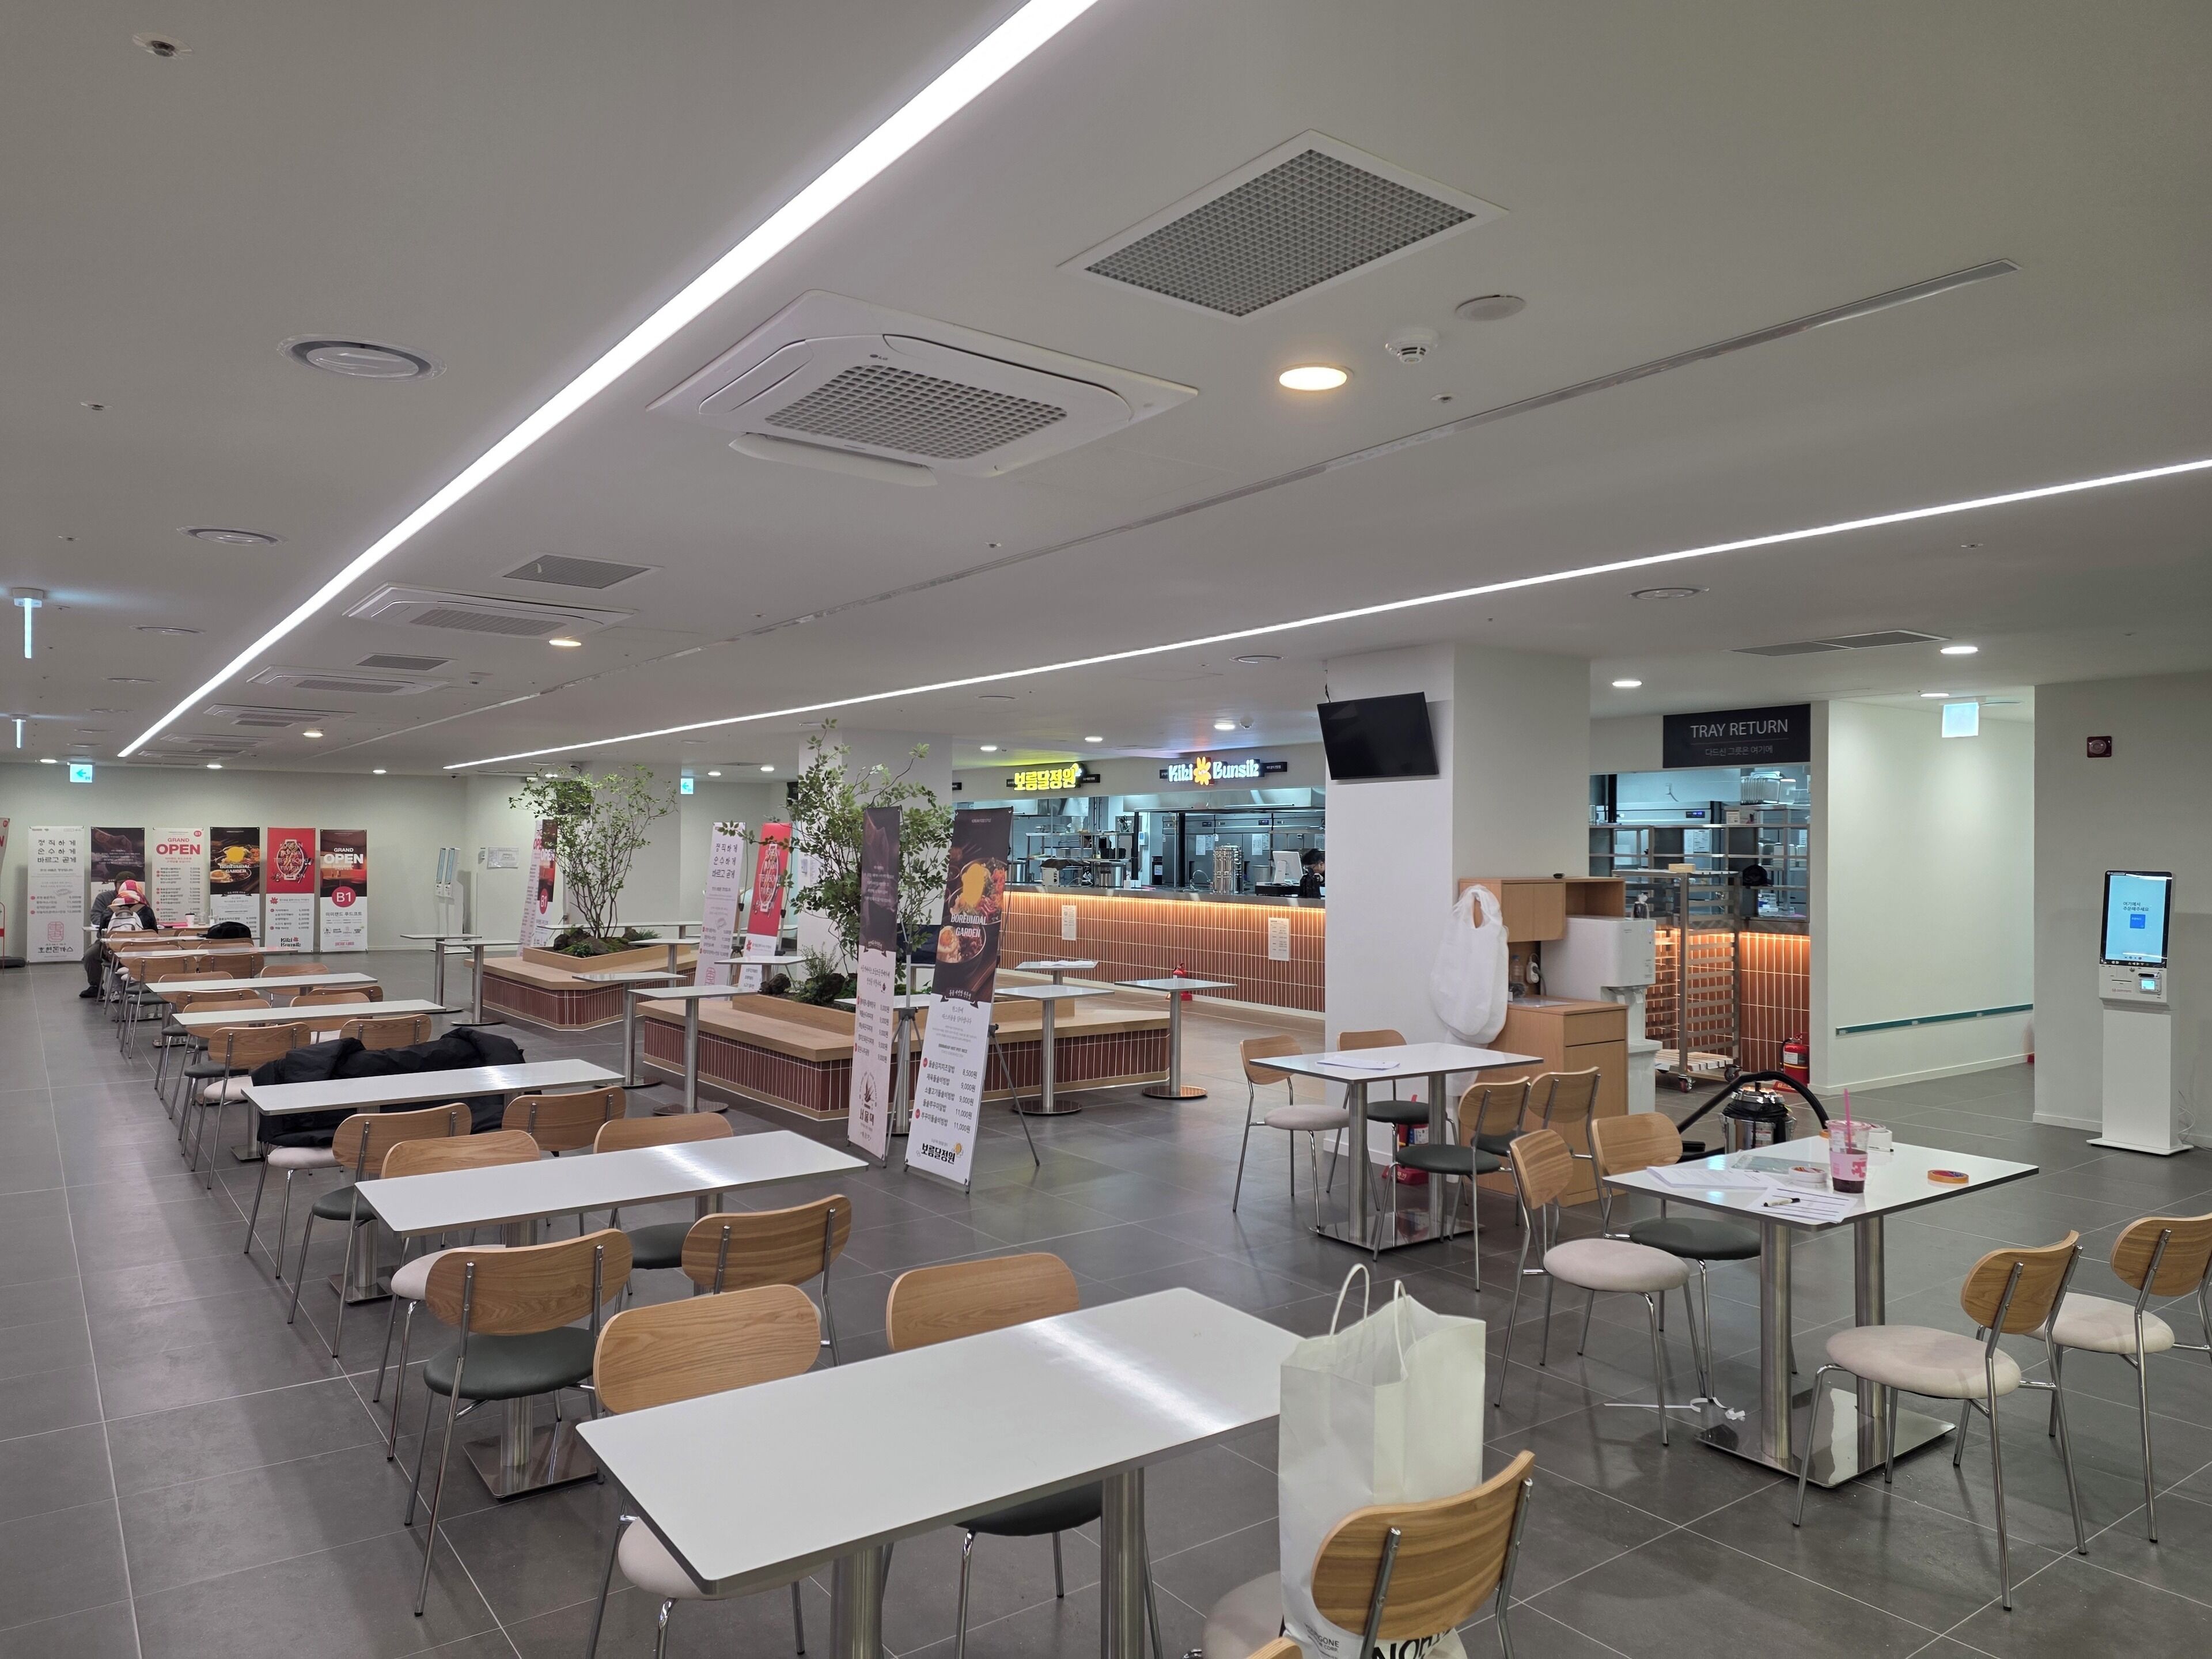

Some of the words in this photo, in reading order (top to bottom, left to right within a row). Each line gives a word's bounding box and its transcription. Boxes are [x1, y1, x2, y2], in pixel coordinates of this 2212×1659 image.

[1690, 724, 1726, 738] TRAY
[1730, 719, 1788, 736] RETURN
[1705, 748, 1726, 756] 다드신
[1728, 747, 1749, 756] 그릇은
[1751, 745, 1773, 754] 여기에
[1169, 764, 1193, 782] Kiki
[1213, 759, 1259, 779] Bunsik
[1014, 768, 1076, 790] 보름달정원
[156, 844, 200, 855] OPEN
[324, 853, 364, 864] OPEN
[336, 892, 351, 902] B1
[540, 896, 547, 907] B1
[951, 914, 987, 925] BOREUMDAL
[956, 927, 980, 938] GARDEN
[963, 1069, 978, 1079] 8,500원
[960, 1082, 976, 1093] 9,000원
[959, 1095, 974, 1106] 9,000원
[956, 1108, 972, 1120] 11,000원
[954, 1122, 971, 1134] 11,000원
[922, 1143, 956, 1165] 보름달정원
